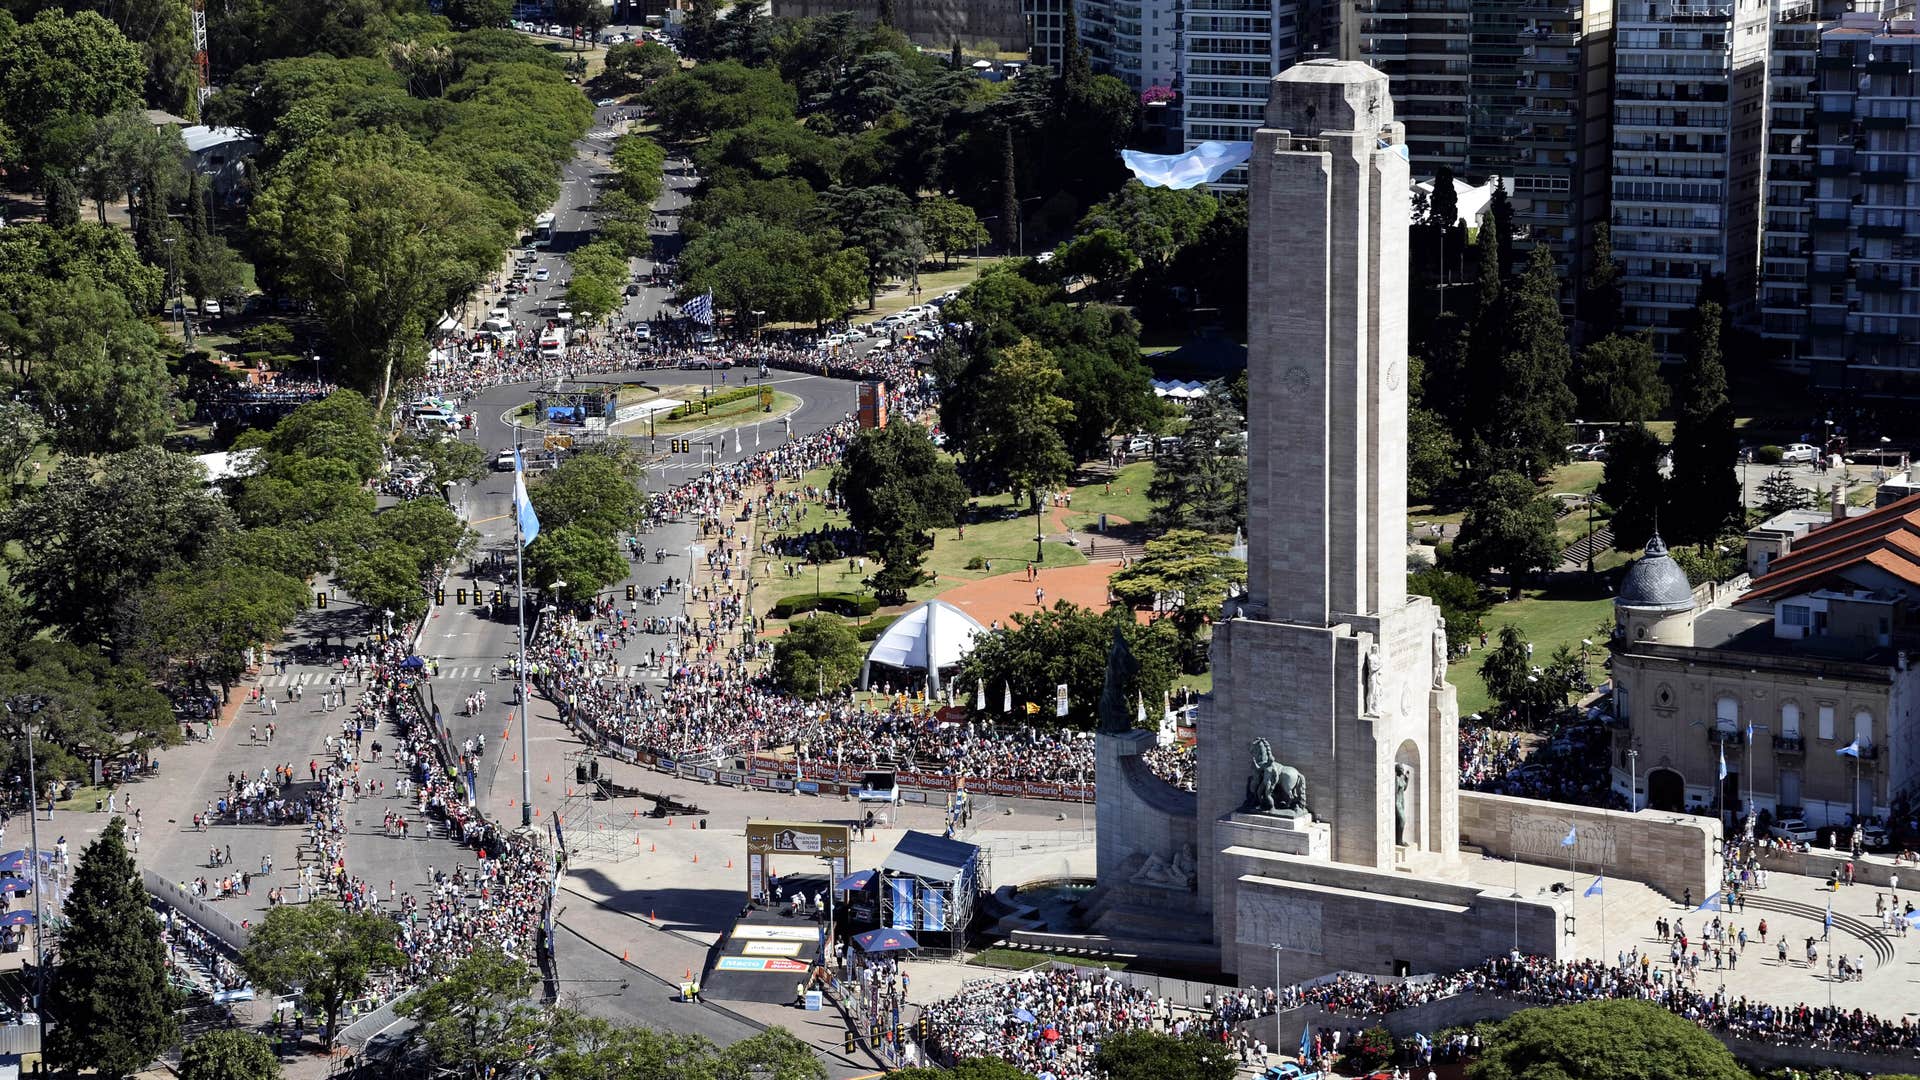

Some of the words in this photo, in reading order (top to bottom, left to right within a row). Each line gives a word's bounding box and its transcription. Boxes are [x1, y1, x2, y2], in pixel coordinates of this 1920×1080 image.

[922, 776, 950, 786] Rosario
[992, 781, 1022, 792] Rosario
[1028, 784, 1058, 795] Rosario
